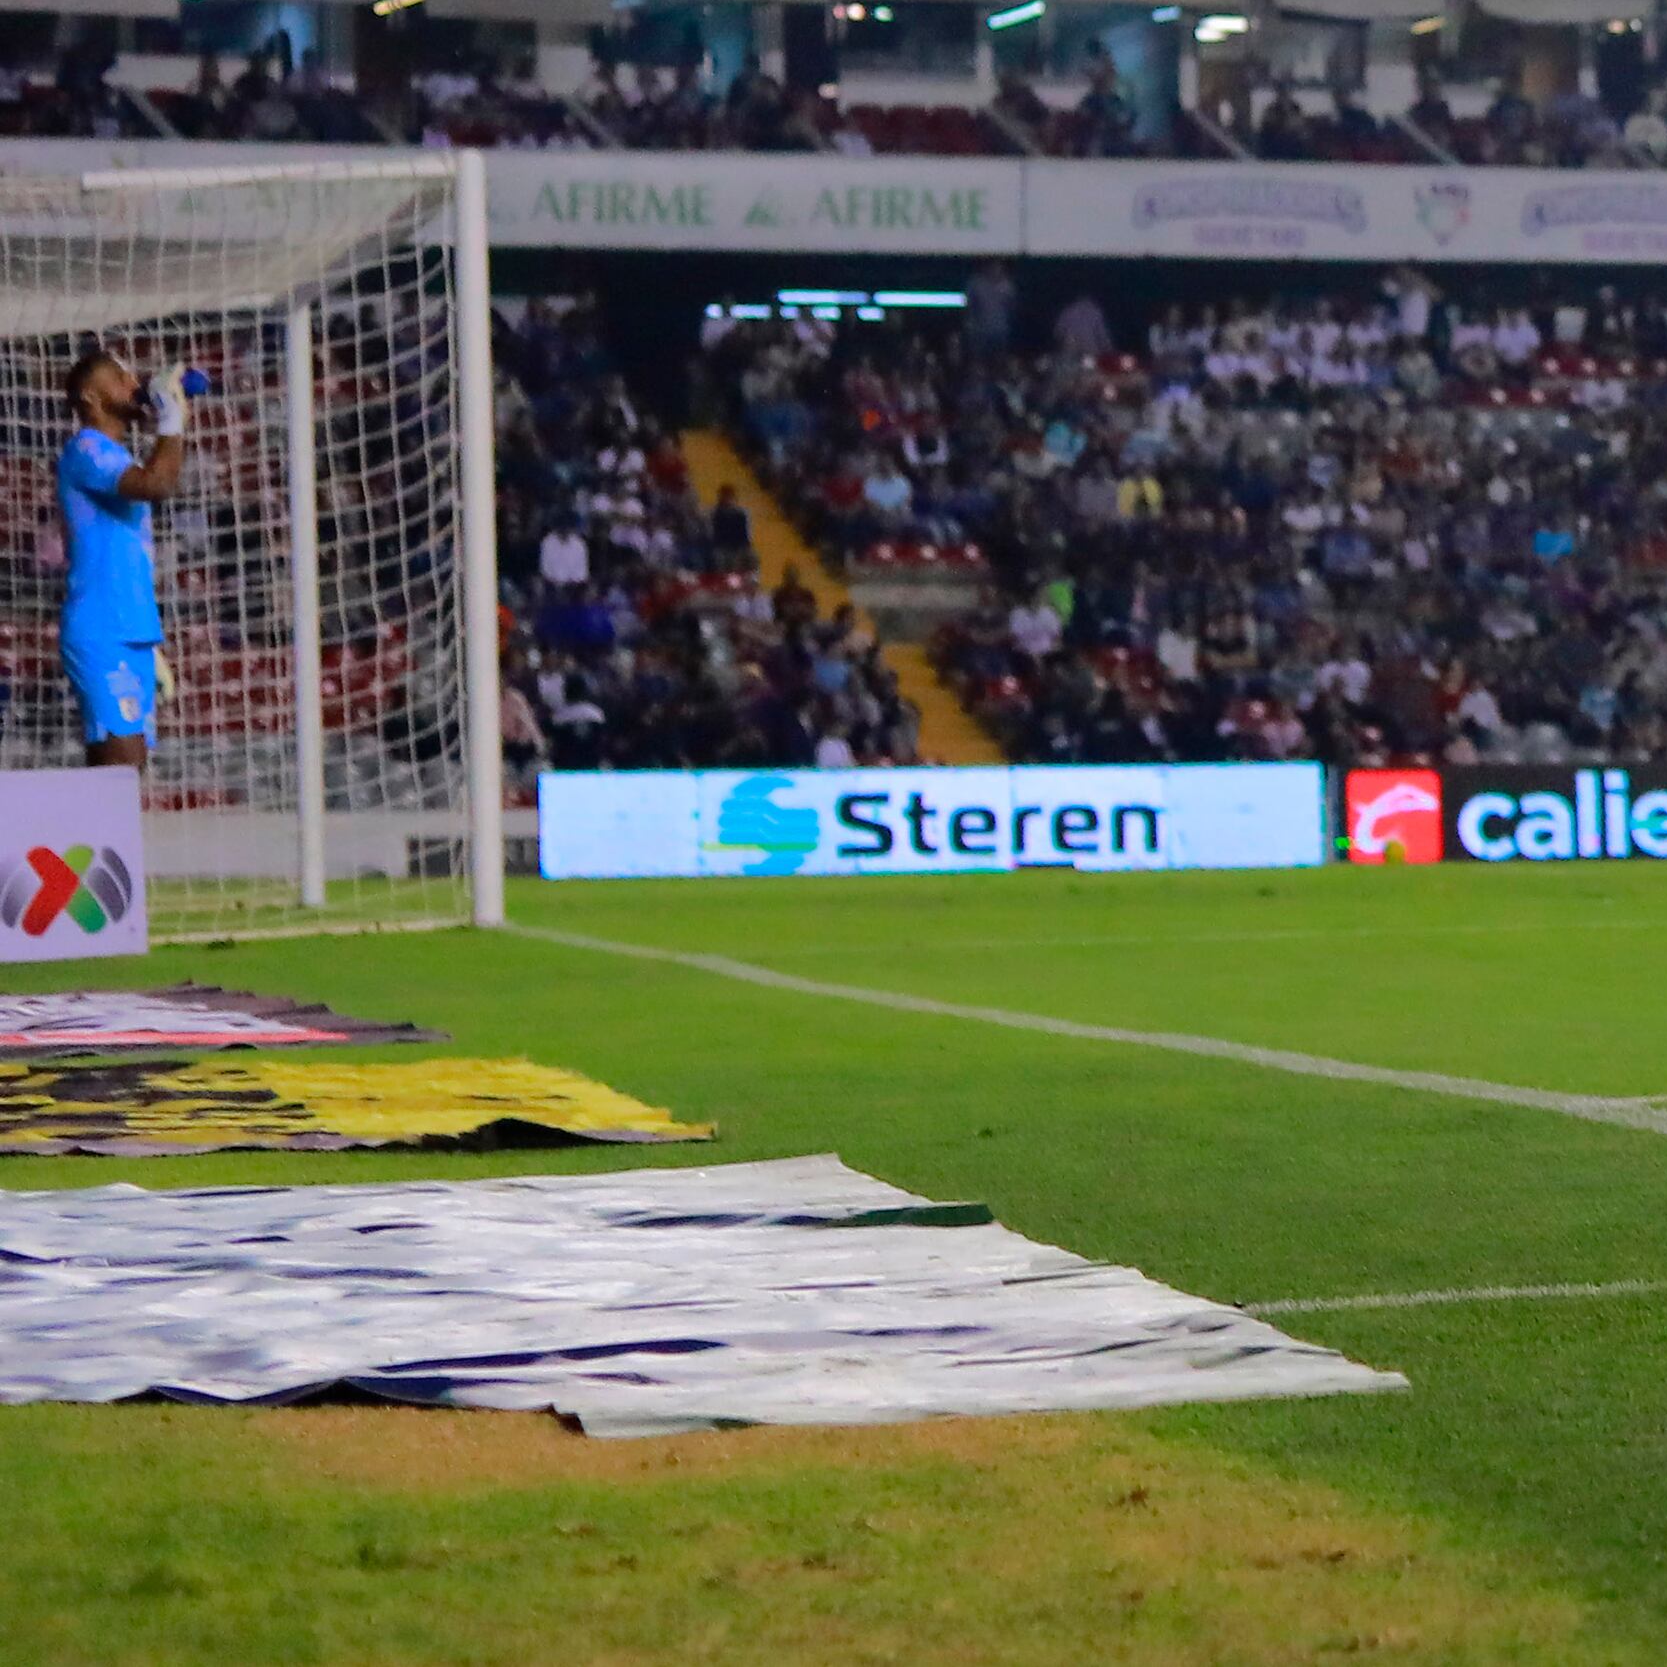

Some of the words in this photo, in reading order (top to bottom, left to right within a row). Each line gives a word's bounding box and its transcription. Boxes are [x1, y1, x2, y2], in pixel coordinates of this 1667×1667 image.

[530, 180, 714, 226] AFIRME
[812, 186, 989, 232] AFIRME
[836, 793, 1160, 856] Steren
